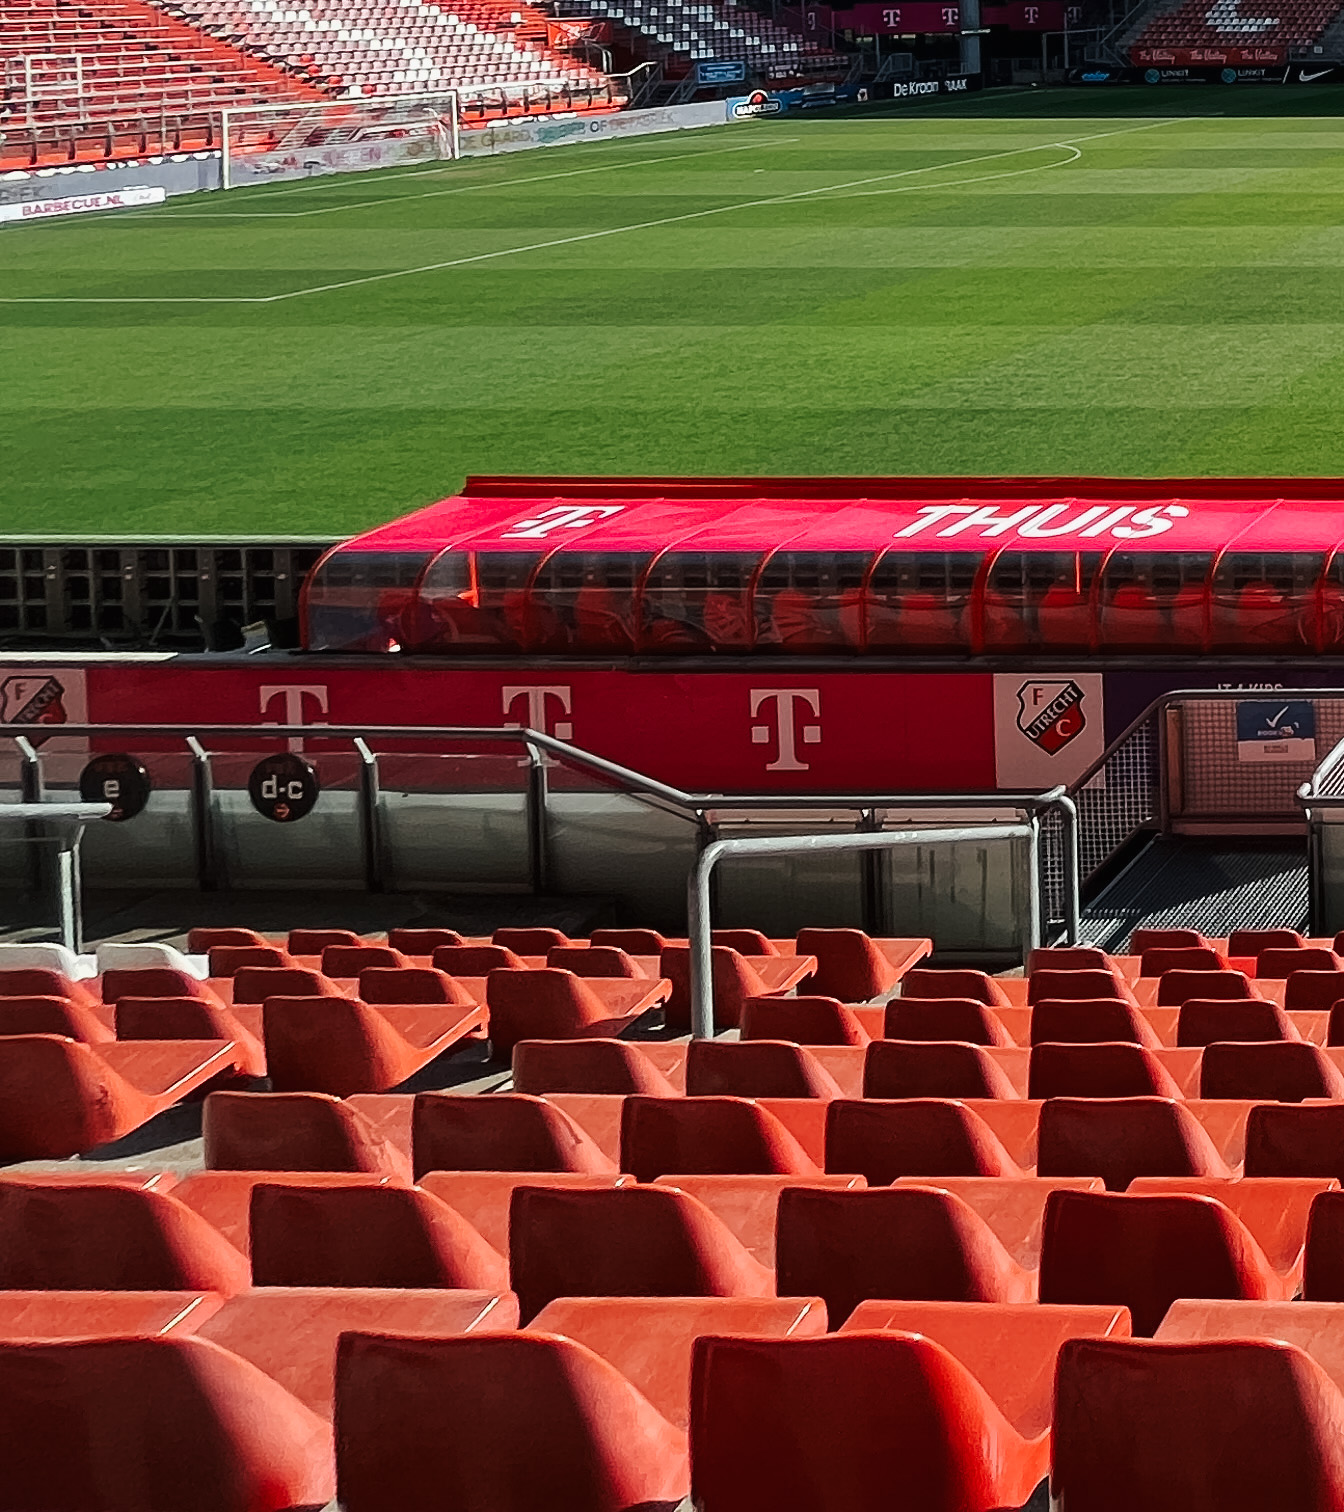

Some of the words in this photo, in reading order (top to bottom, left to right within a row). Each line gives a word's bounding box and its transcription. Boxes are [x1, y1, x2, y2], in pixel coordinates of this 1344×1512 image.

[893, 82, 909, 98] De
[590, 120, 607, 133] OF
[22, 195, 124, 217] BARBECUE.NL
[893, 504, 1190, 539] THUIS
[1032, 687, 1044, 706] F
[1025, 686, 1078, 739] UTRECHT
[750, 689, 821, 771] T
[1055, 718, 1072, 737] C
[103, 779, 120, 798] e
